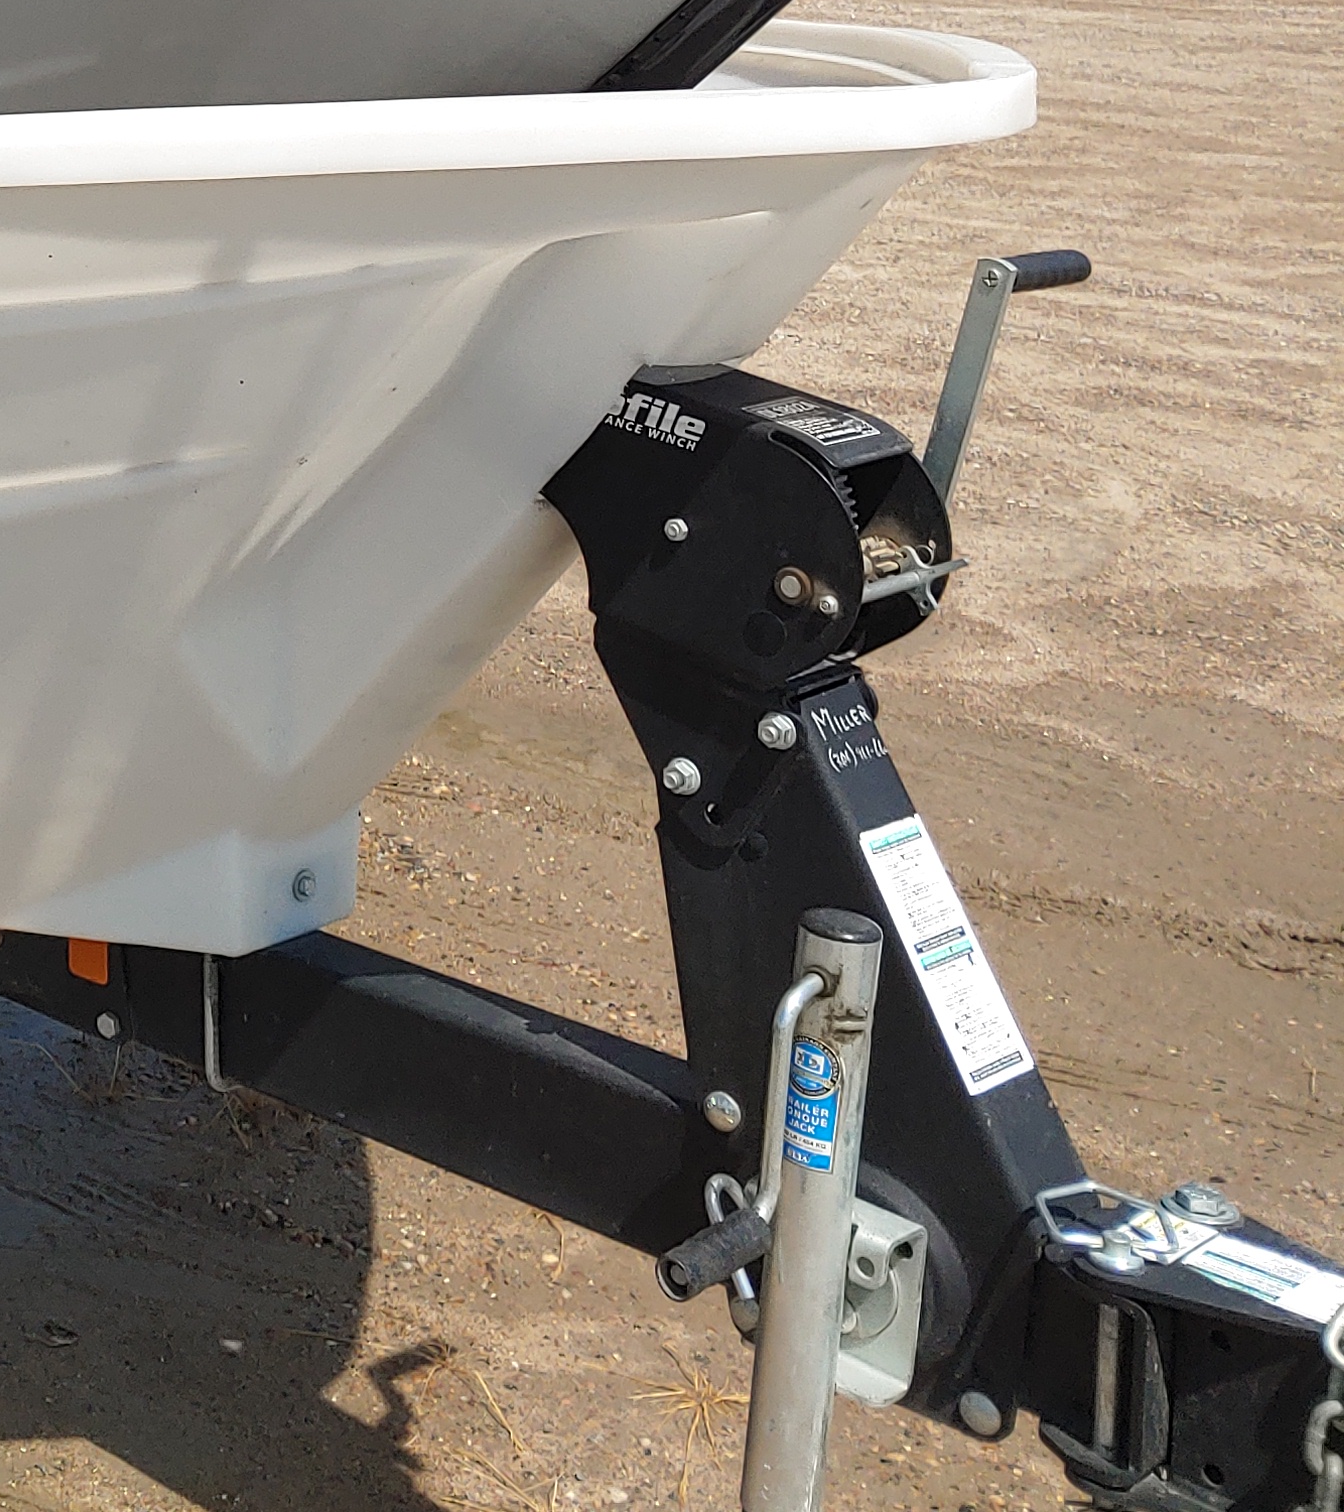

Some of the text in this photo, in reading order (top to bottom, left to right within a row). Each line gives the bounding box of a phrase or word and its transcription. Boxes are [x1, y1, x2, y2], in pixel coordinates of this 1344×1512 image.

[604, 415, 697, 452] ANCE WINCH
[811, 704, 872, 741] MILLER
[787, 1106, 828, 1128] ONGUE
[788, 1096, 829, 1118] RAILER
[789, 1118, 816, 1135] JACK
